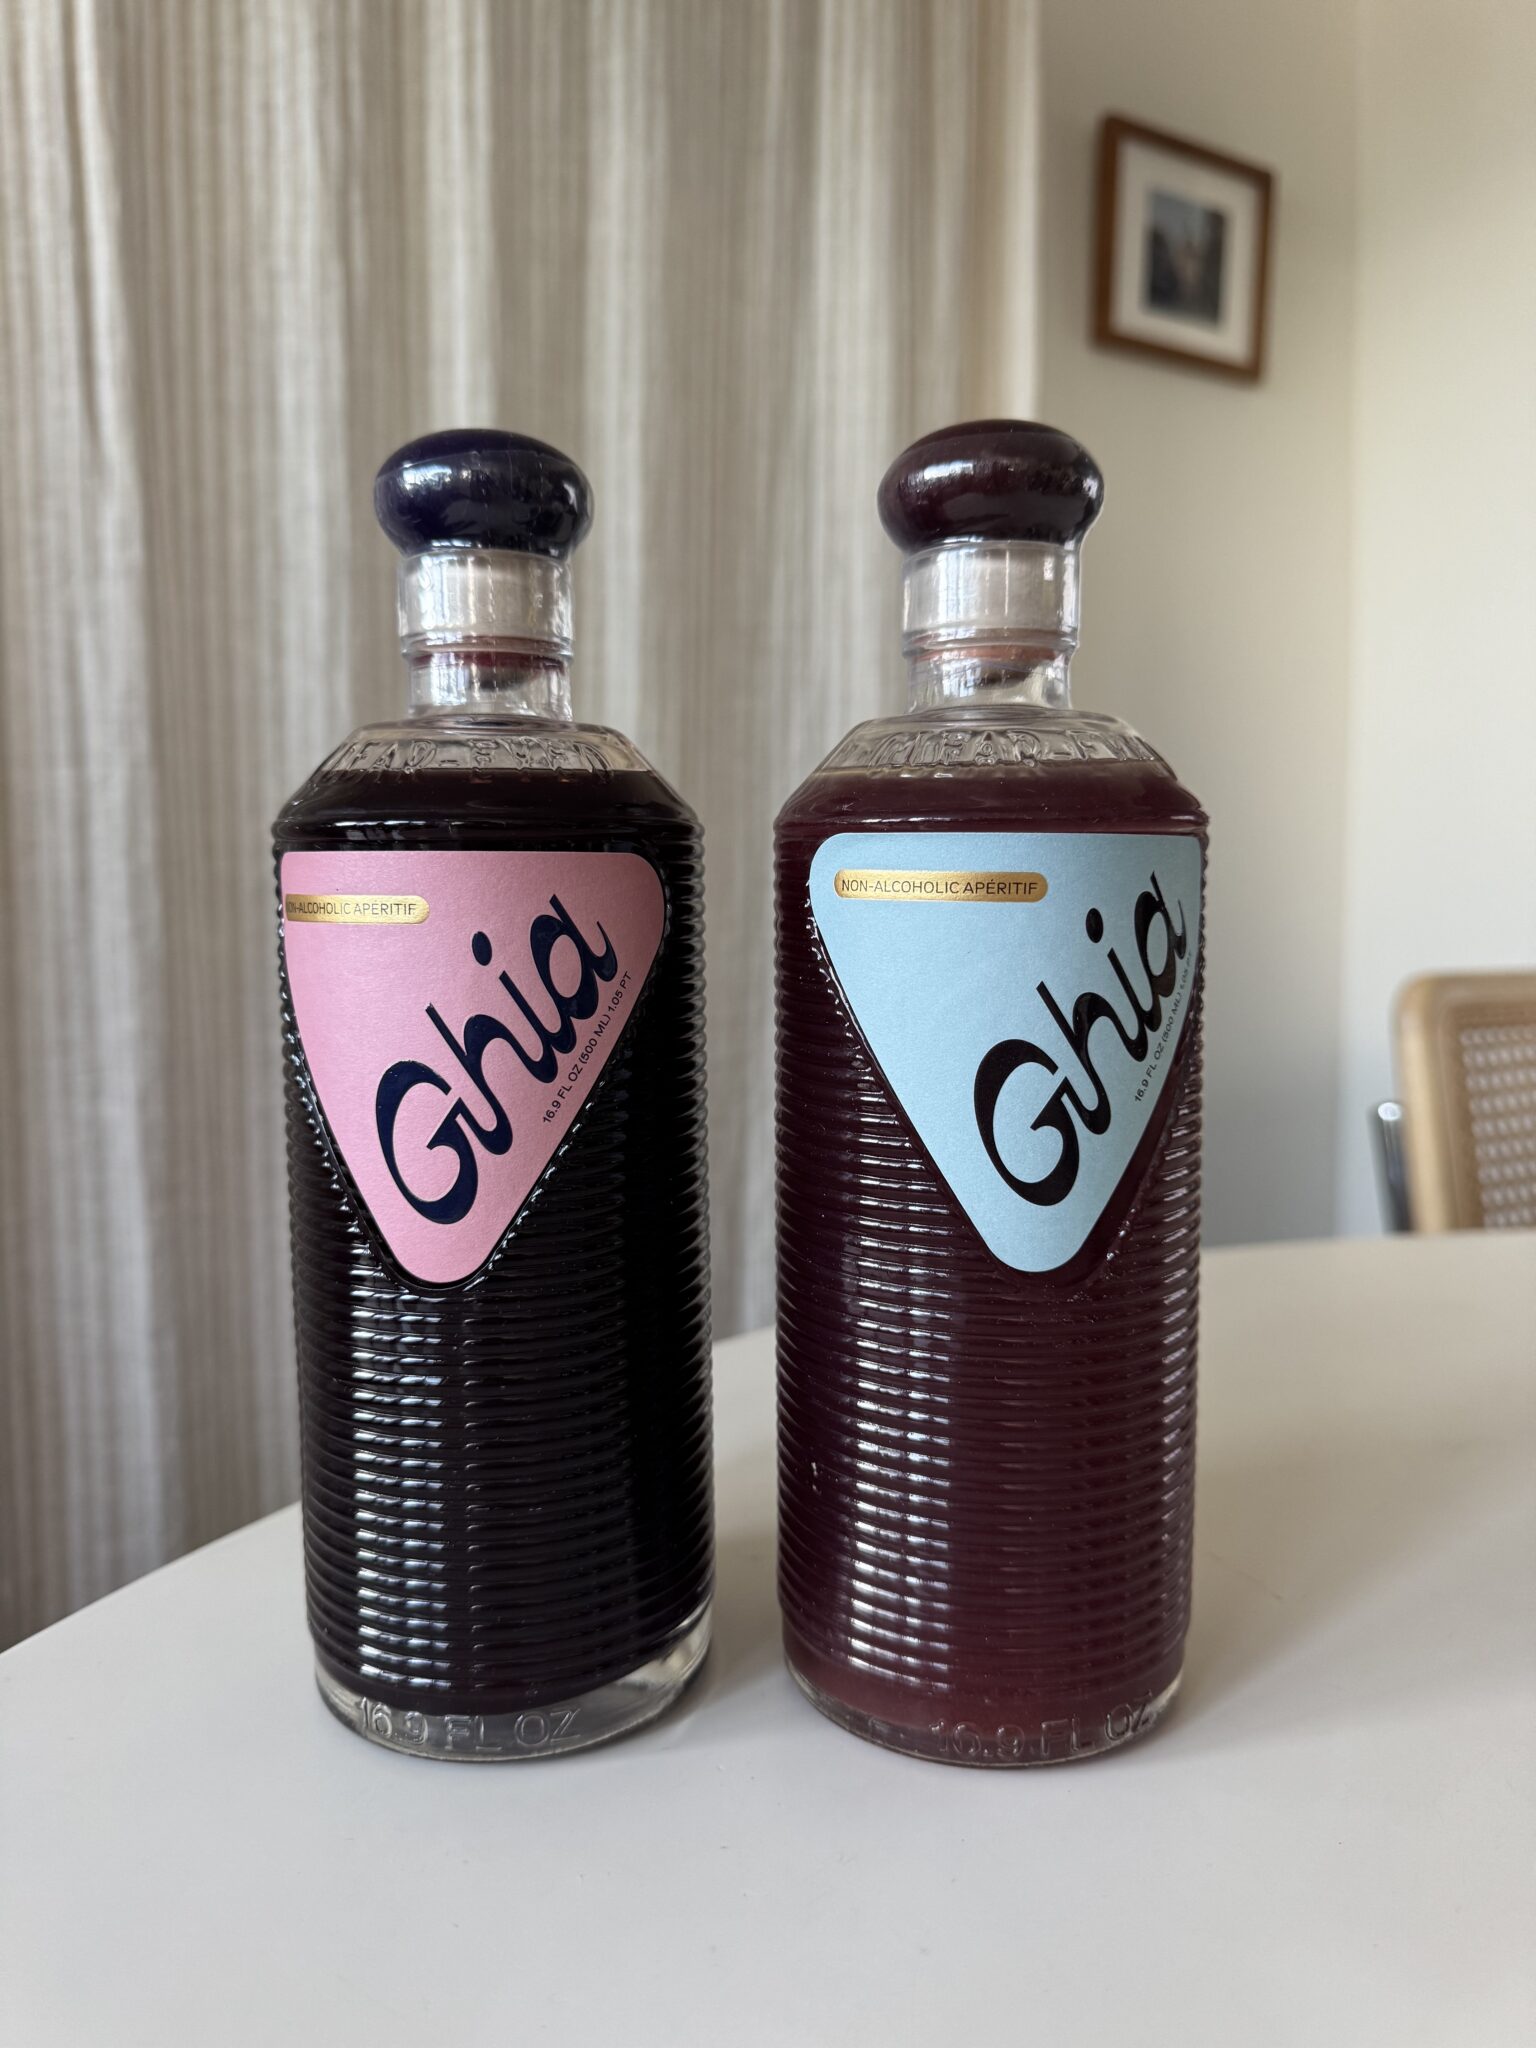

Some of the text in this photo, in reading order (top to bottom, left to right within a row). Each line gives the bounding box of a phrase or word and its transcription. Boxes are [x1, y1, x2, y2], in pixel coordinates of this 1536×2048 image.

[841, 879, 1039, 895] NON-ALCOHOLIC APÉRITIF
[375, 893, 618, 1225] Ghia
[542, 971, 632, 1124] 16.9 FL OZ (500 ML) 1.05 PT
[974, 871, 1187, 1206] Ghia
[1135, 1079, 1150, 1102] 16.9
[1147, 1063, 1158, 1078] FL
[1154, 1043, 1164, 1060] OZ
[1162, 1016, 1174, 1043] (500
[444, 1715, 502, 1751] FL
[514, 1707, 581, 1746] OZ
[929, 1718, 1026, 1759] 16.9
[1041, 1714, 1095, 1756] FL
